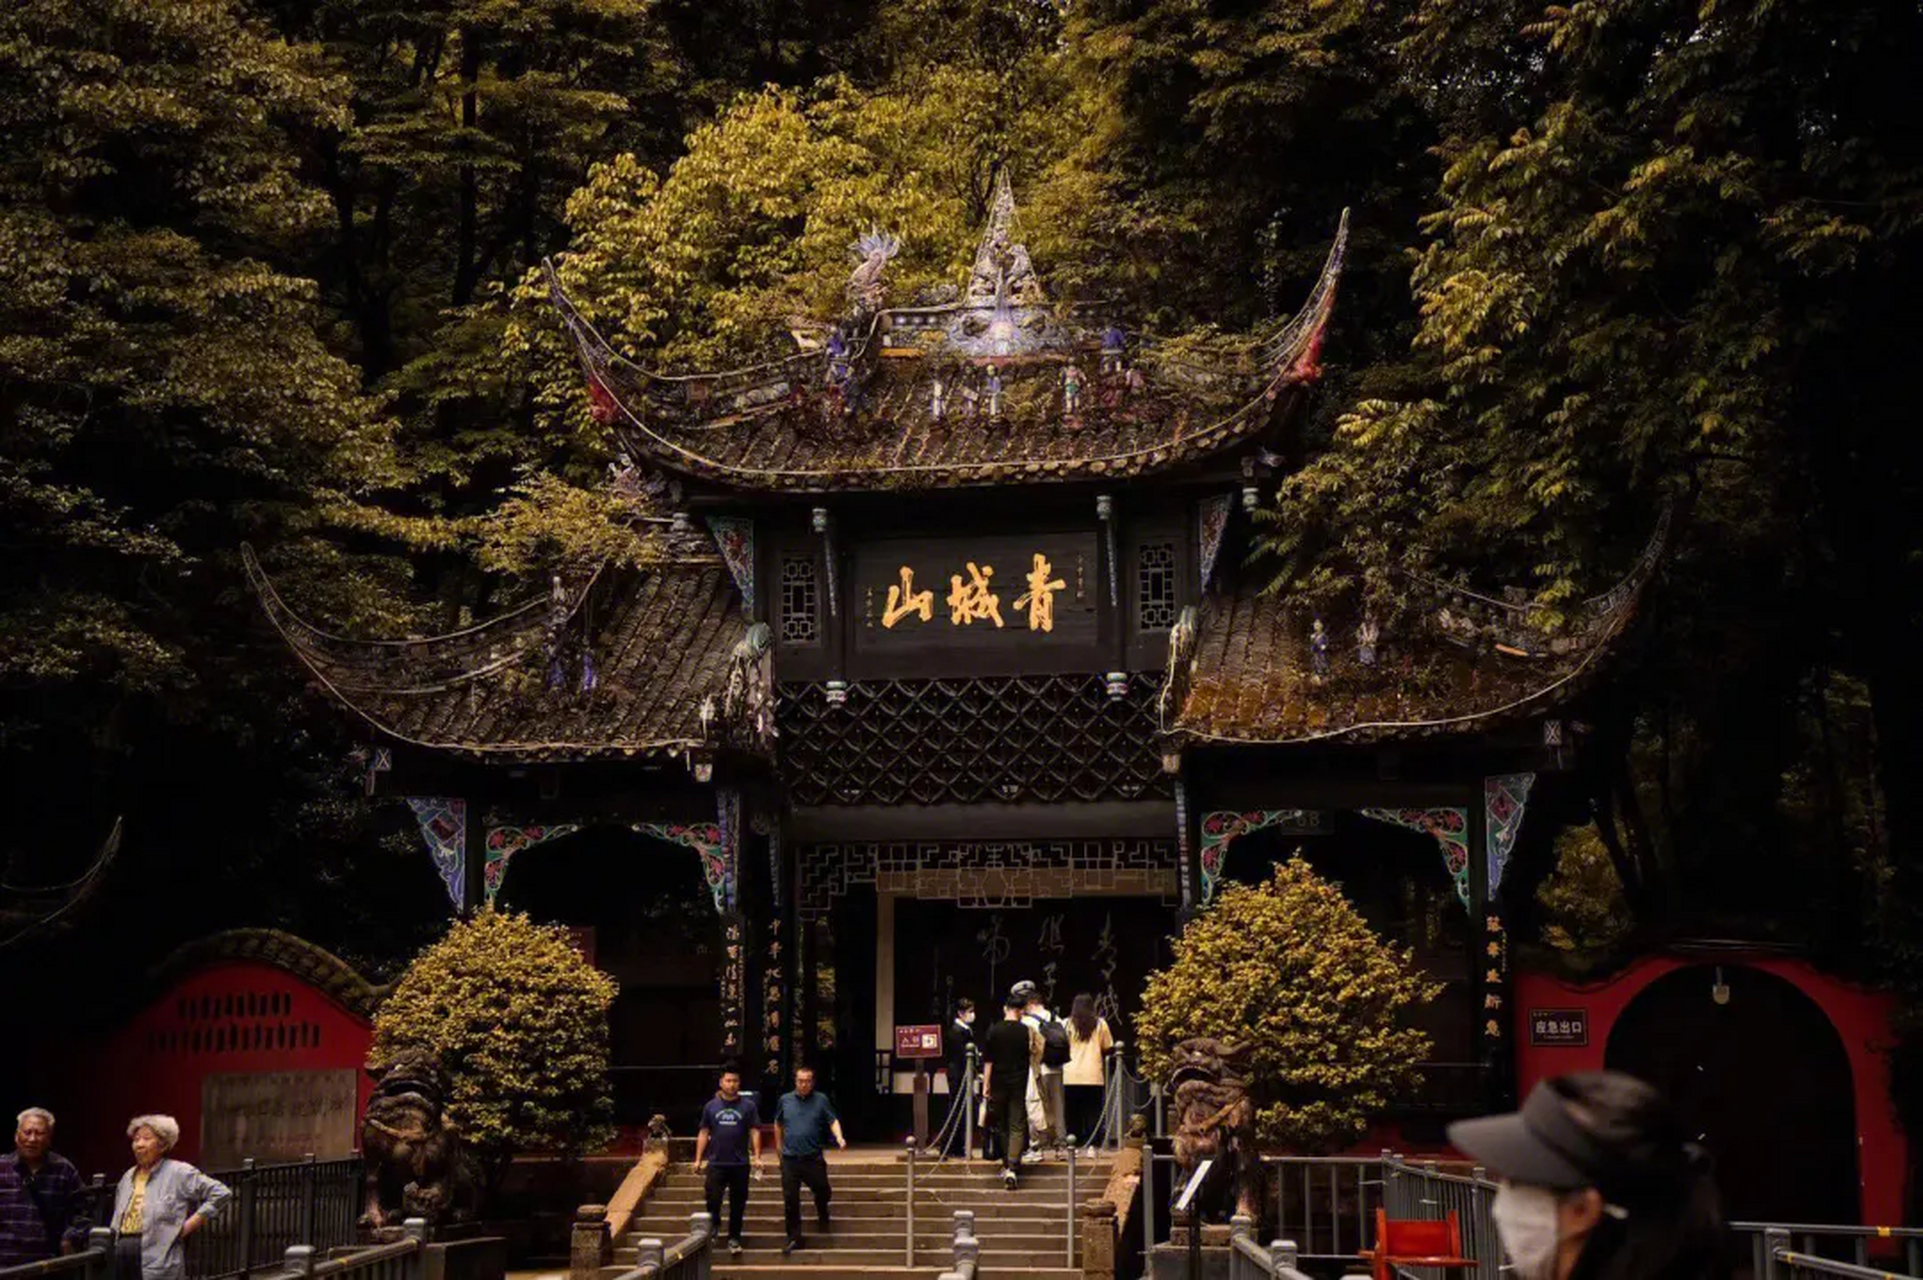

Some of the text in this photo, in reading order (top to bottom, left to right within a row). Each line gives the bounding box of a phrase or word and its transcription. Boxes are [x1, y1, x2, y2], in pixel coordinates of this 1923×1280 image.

[881, 553, 1066, 633] 青城山
[1535, 1020, 1582, 1034] 应急出口
